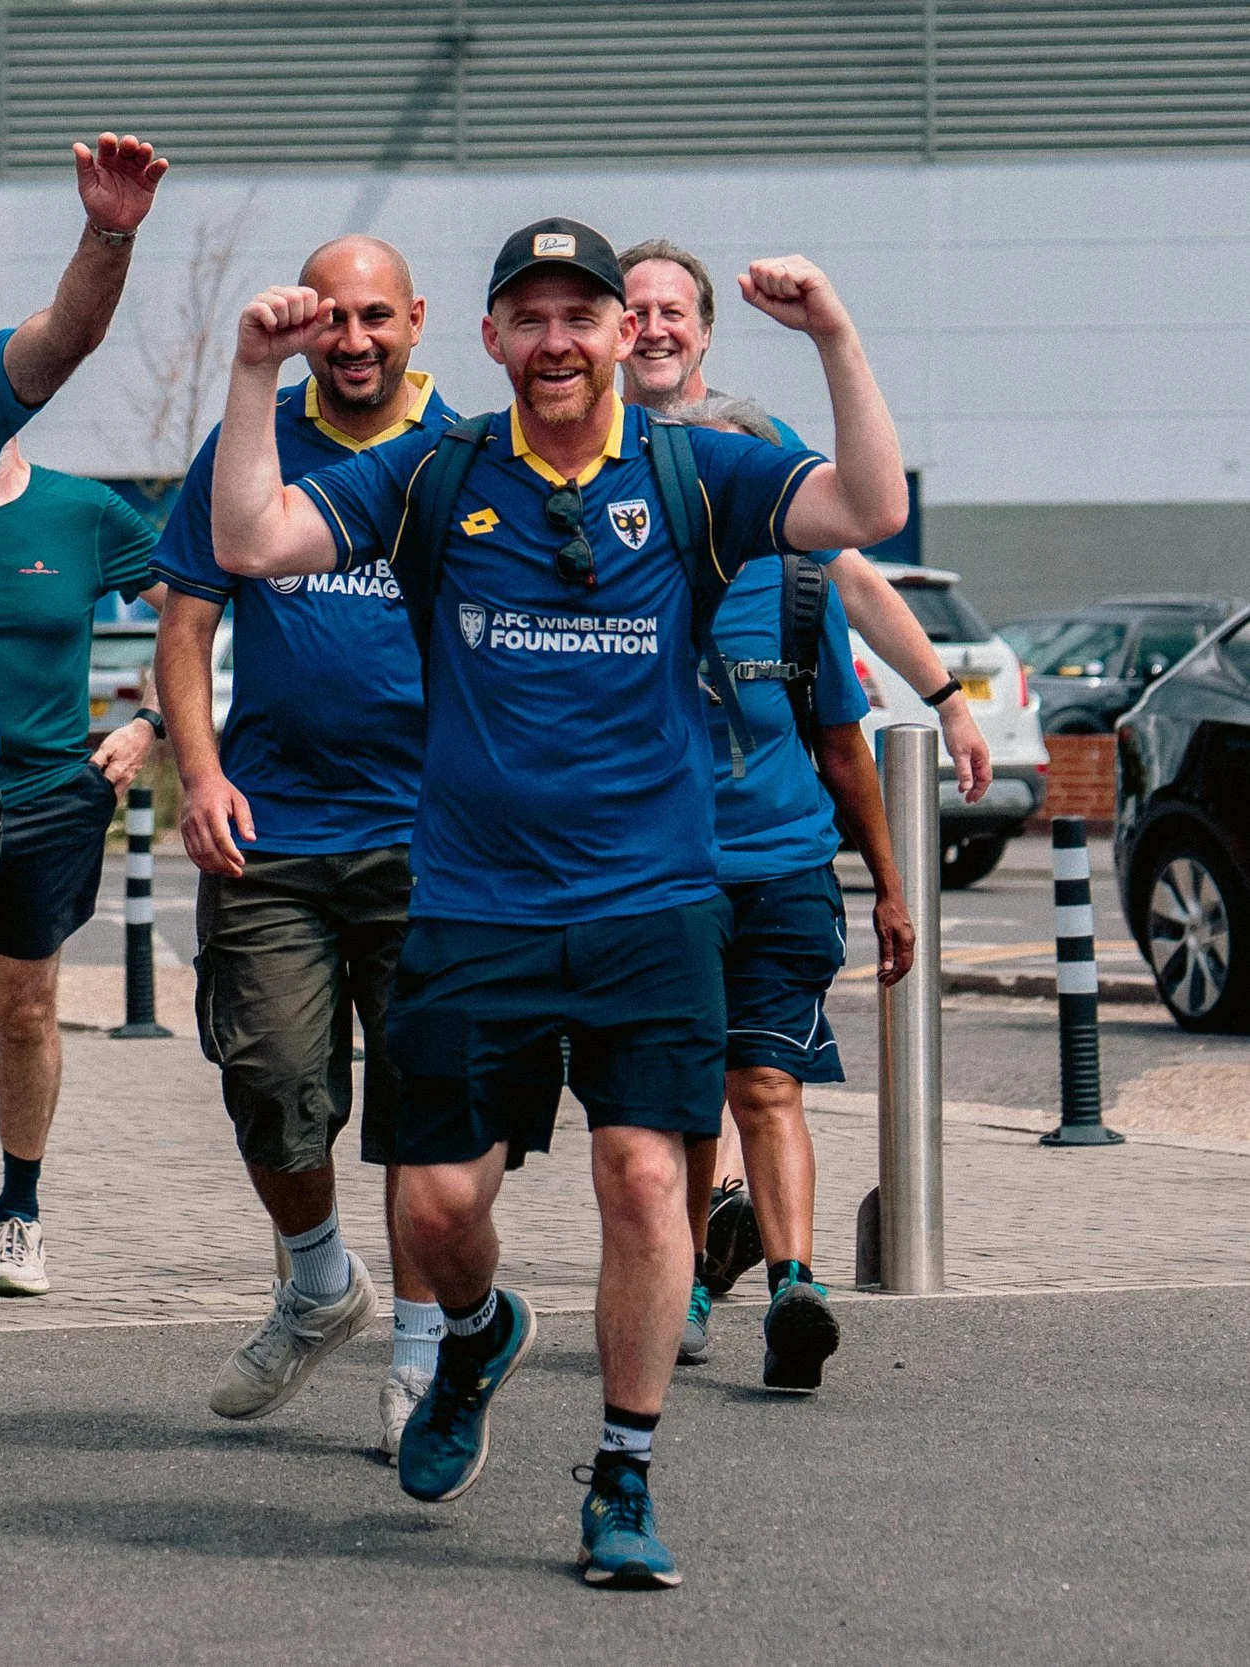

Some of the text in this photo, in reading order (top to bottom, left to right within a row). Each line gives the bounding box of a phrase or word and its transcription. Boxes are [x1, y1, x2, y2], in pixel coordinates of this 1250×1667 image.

[307, 573, 403, 600] MANAG
[492, 612, 657, 633] AFC WIMBLEDON
[490, 630, 658, 654] FOUNDATION
